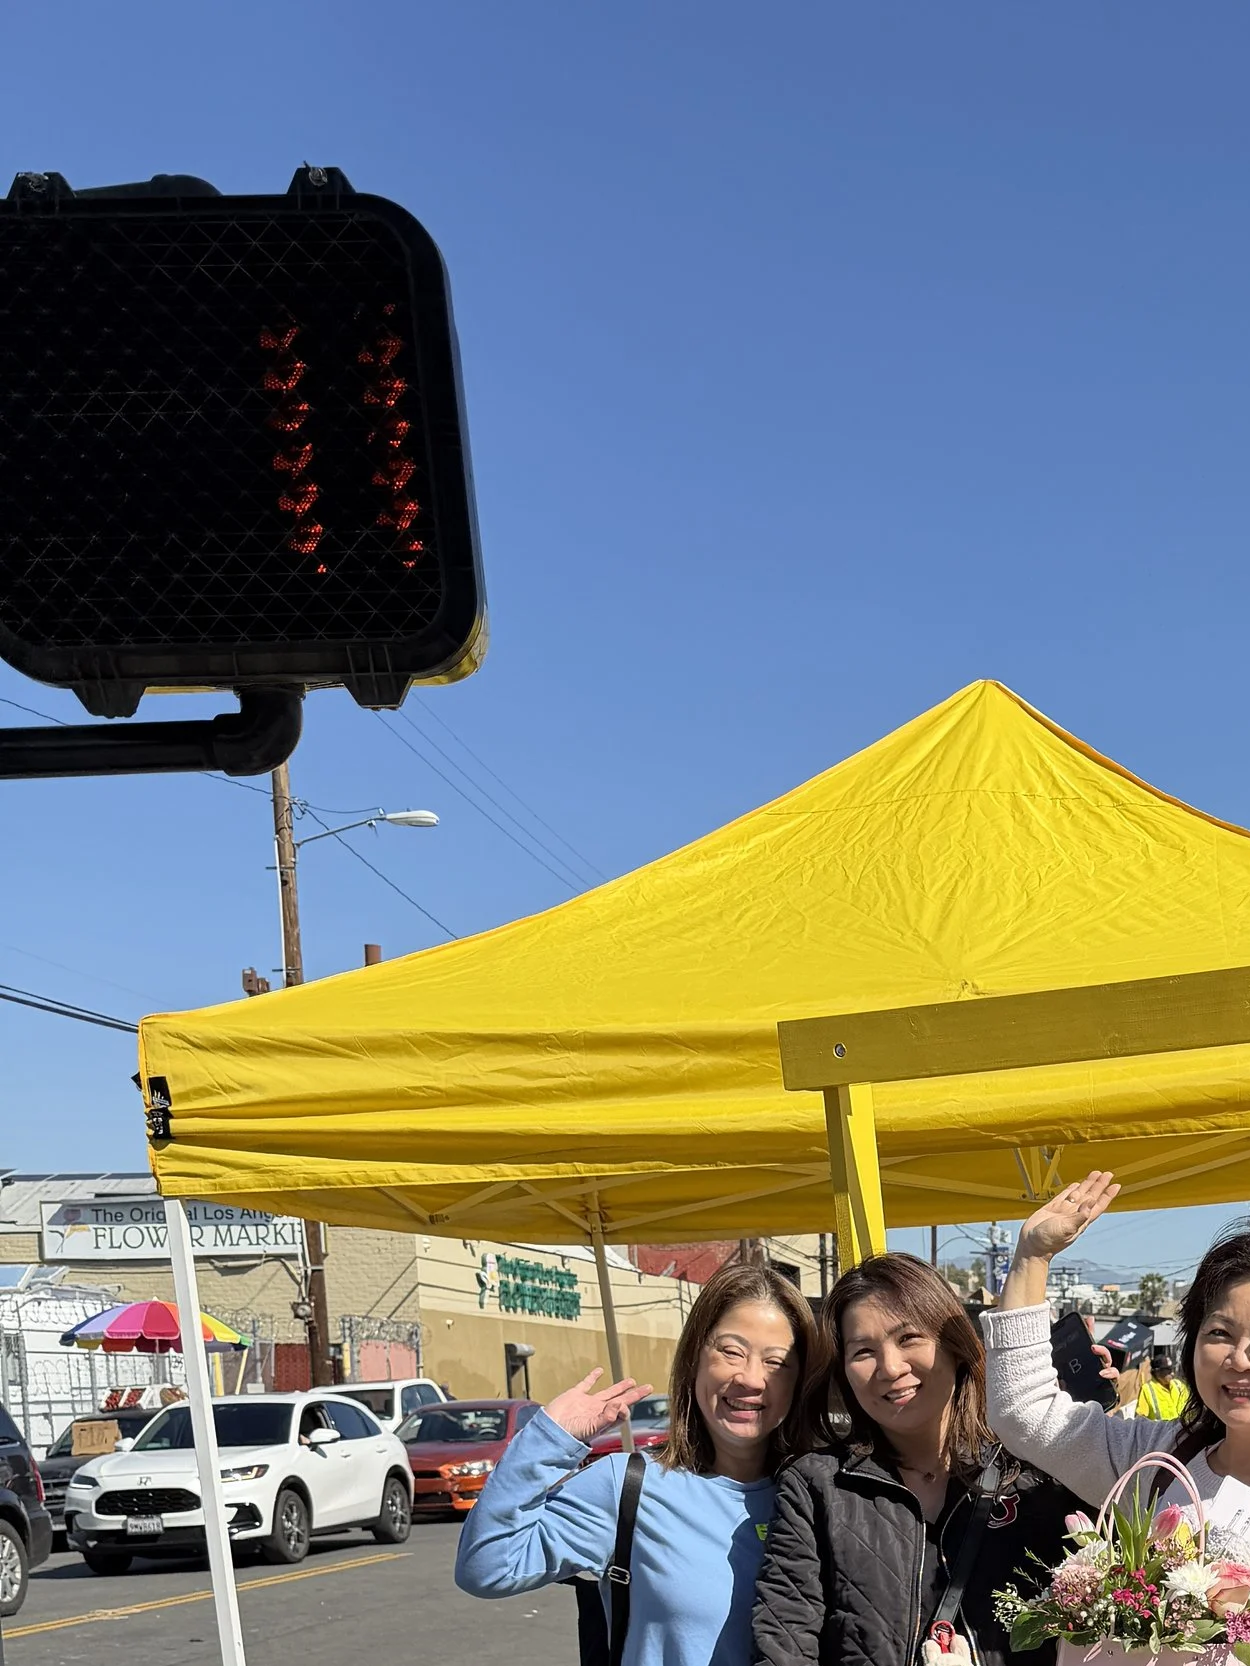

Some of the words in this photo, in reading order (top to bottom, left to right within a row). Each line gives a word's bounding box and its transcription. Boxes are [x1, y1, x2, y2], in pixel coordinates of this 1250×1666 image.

[91, 1208, 124, 1223] The
[130, 1206, 197, 1223] Origal
[203, 1207, 234, 1220] Los
[93, 1225, 205, 1250] FLOWR
[213, 1223, 303, 1247] MARKE
